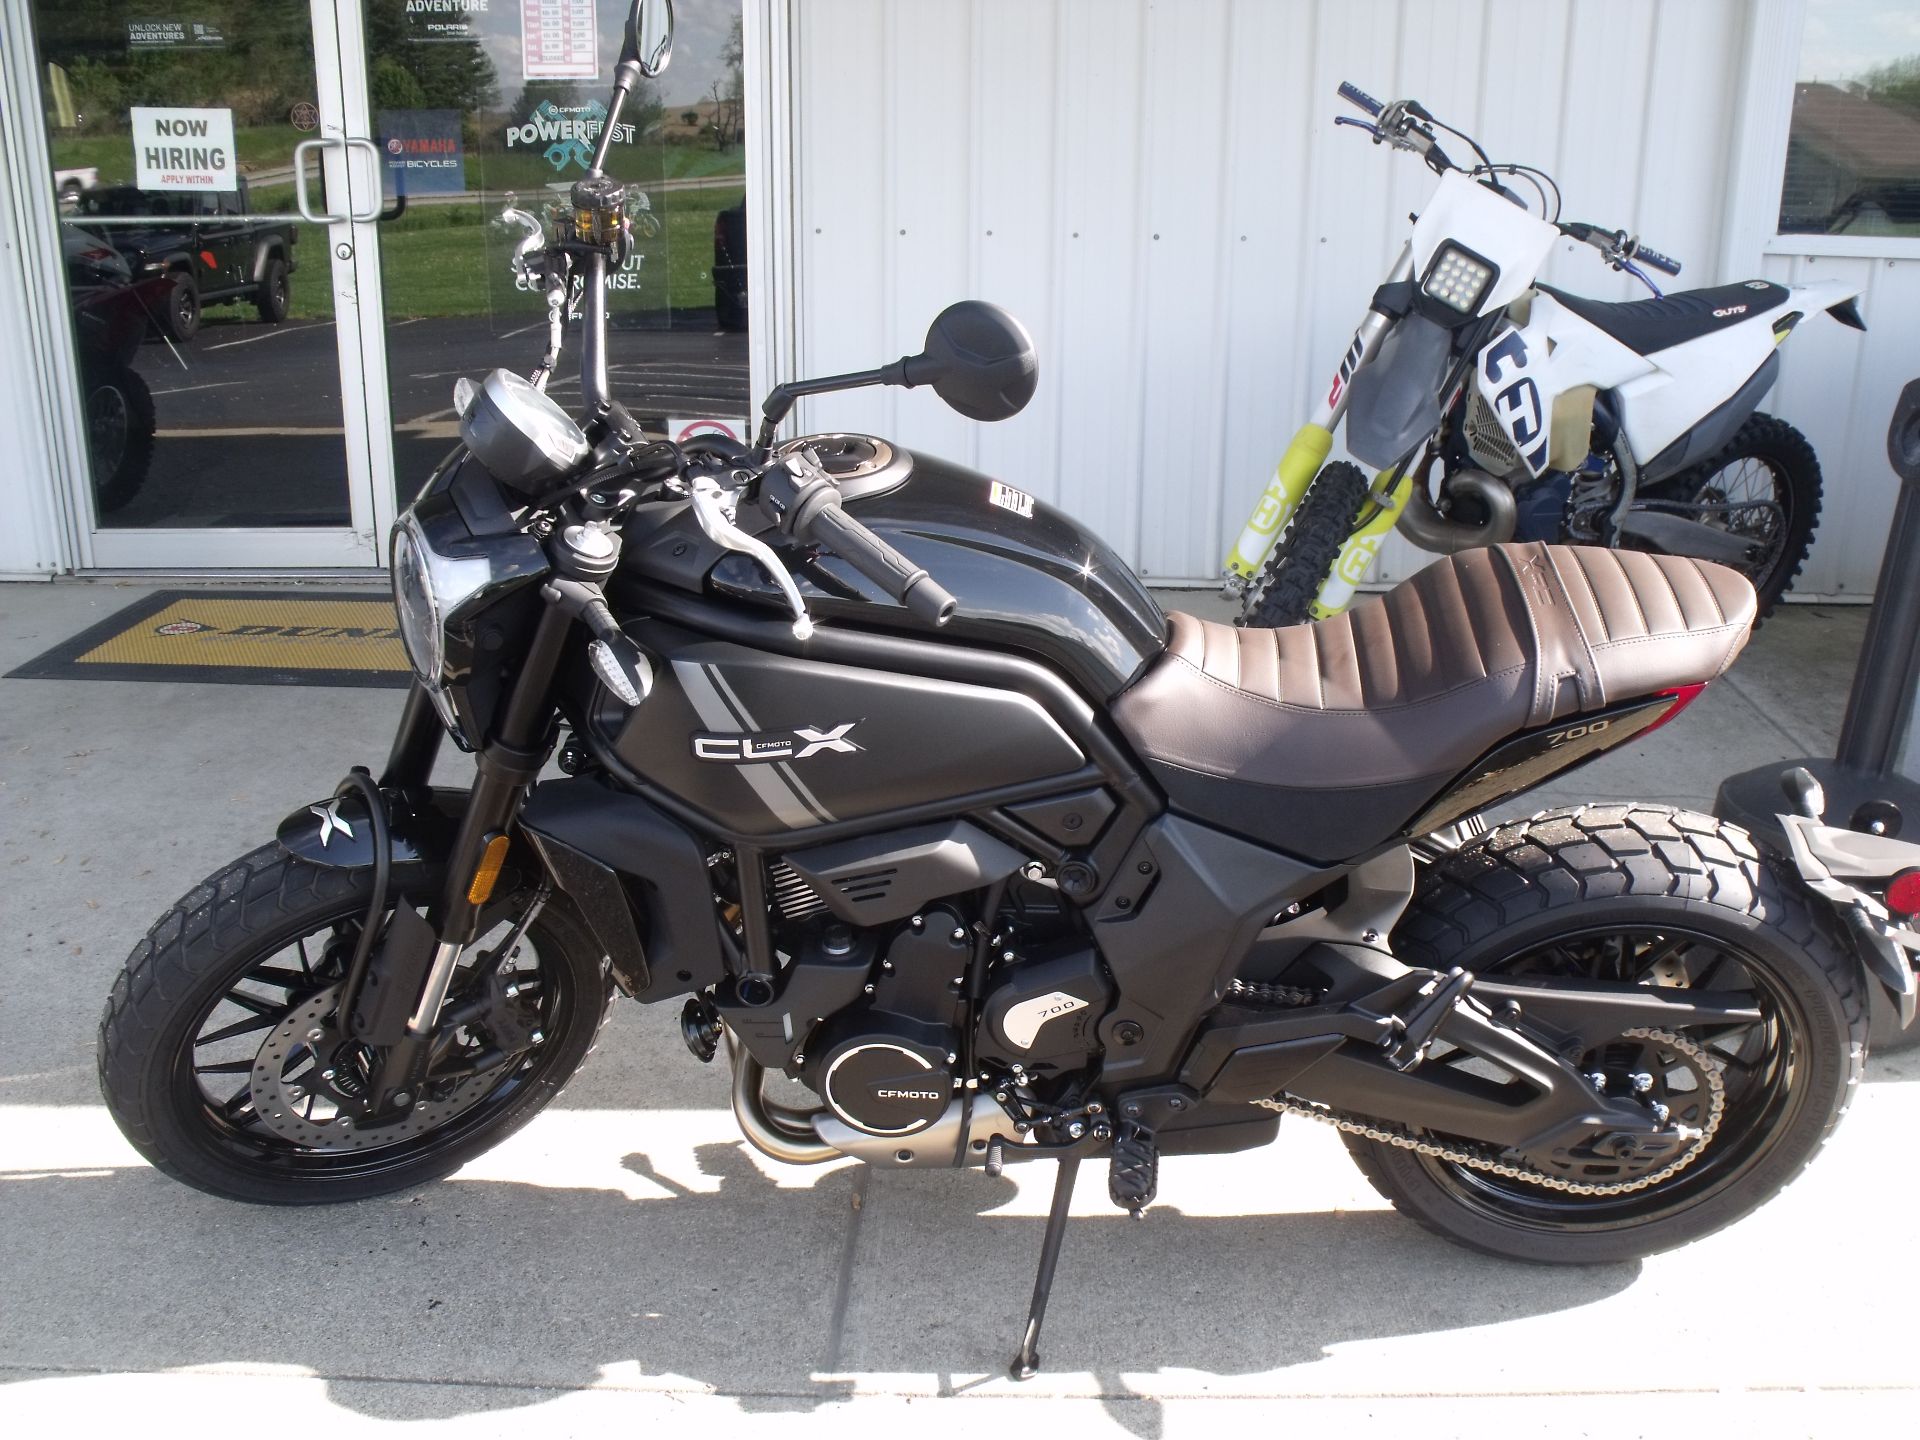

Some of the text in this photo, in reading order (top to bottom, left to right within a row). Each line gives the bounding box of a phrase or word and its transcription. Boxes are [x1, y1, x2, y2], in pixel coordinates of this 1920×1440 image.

[406, 0, 488, 12] ADVENTURE
[128, 23, 182, 32] UNLOCK NEW
[130, 32, 185, 40] ADVENTURES
[155, 119, 208, 137] NOW
[144, 146, 226, 171] HIRING
[406, 160, 458, 168] BICYCLES
[161, 174, 214, 185] APPLY WITHIN
[1546, 720, 1609, 745] 700
[756, 740, 792, 749] CFMOTO
[1038, 1001, 1075, 1018] 700
[877, 1089, 939, 1100] CFMOTO
